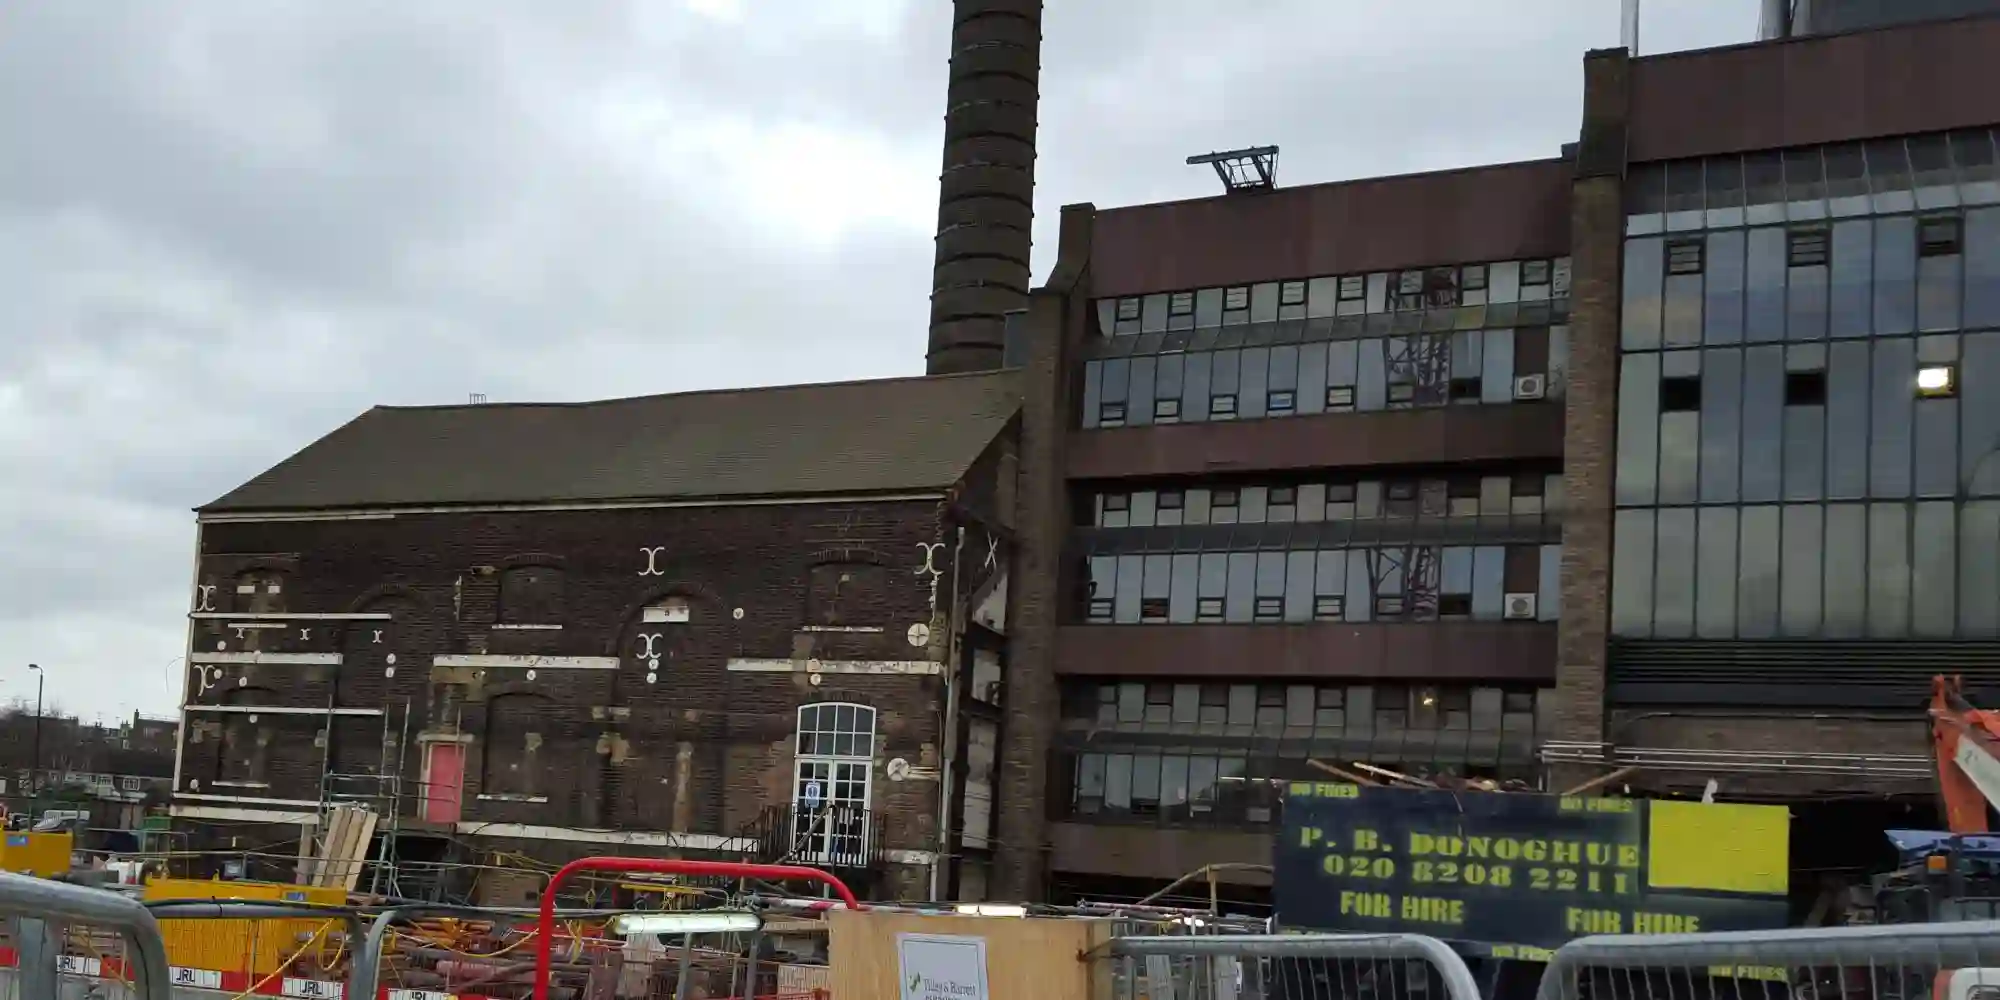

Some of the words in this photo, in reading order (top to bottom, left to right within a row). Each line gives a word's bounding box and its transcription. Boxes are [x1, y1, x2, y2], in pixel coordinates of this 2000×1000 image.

[1409, 832, 1640, 867] DONOGHUE
[1323, 854, 1395, 879] 020
[1411, 861, 1512, 887] 8208
[1529, 867, 1628, 894] 2211
[1340, 891, 1392, 918] FOR
[1401, 895, 1464, 925] HIRE
[1567, 906, 1622, 933] FOR
[1633, 911, 1700, 934] HIRE
[59, 955, 76, 971] JRL
[175, 968, 196, 983] JRL
[302, 981, 323, 995] JRL
